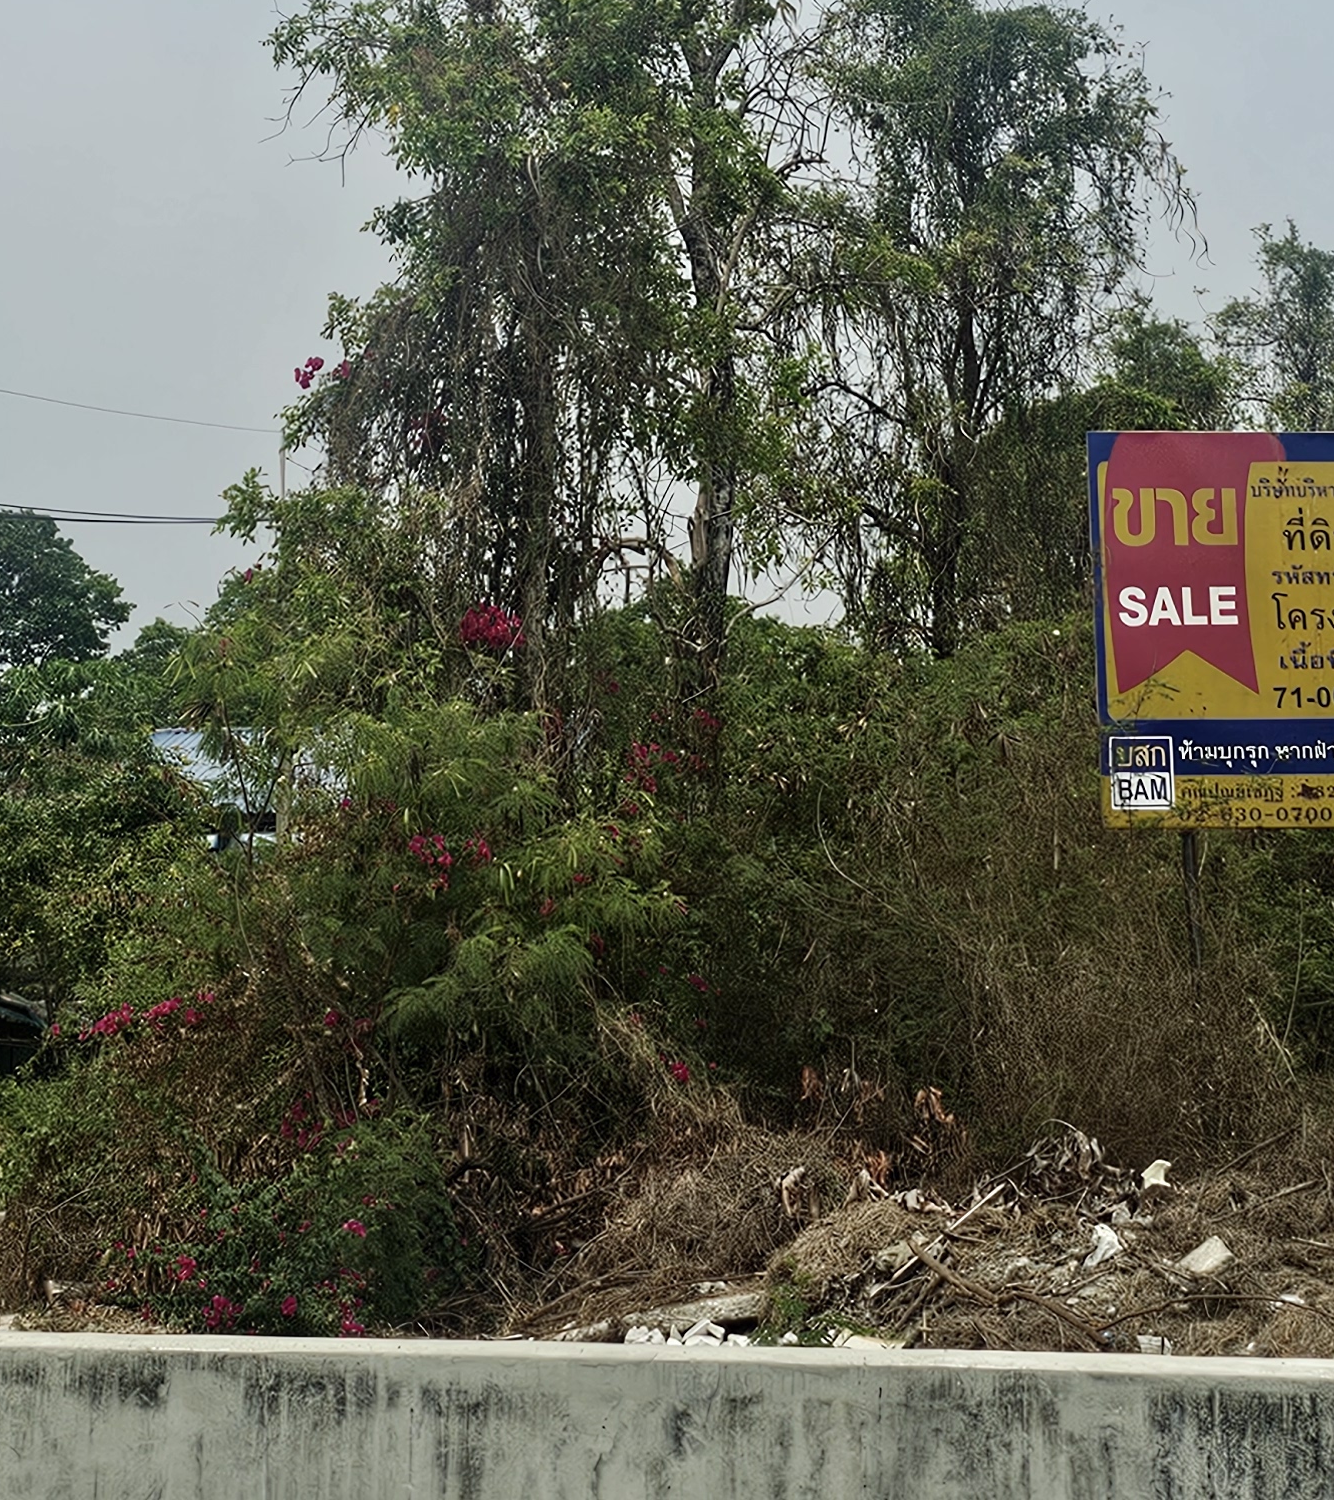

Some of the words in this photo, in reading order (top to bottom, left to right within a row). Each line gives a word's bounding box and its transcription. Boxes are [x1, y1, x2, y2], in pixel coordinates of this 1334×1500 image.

[1112, 488, 1238, 547] ขาย
[1118, 586, 1239, 627] SALE
[1178, 739, 1269, 768] ห้ามบุกรุก
[1119, 778, 1167, 801] BAM
